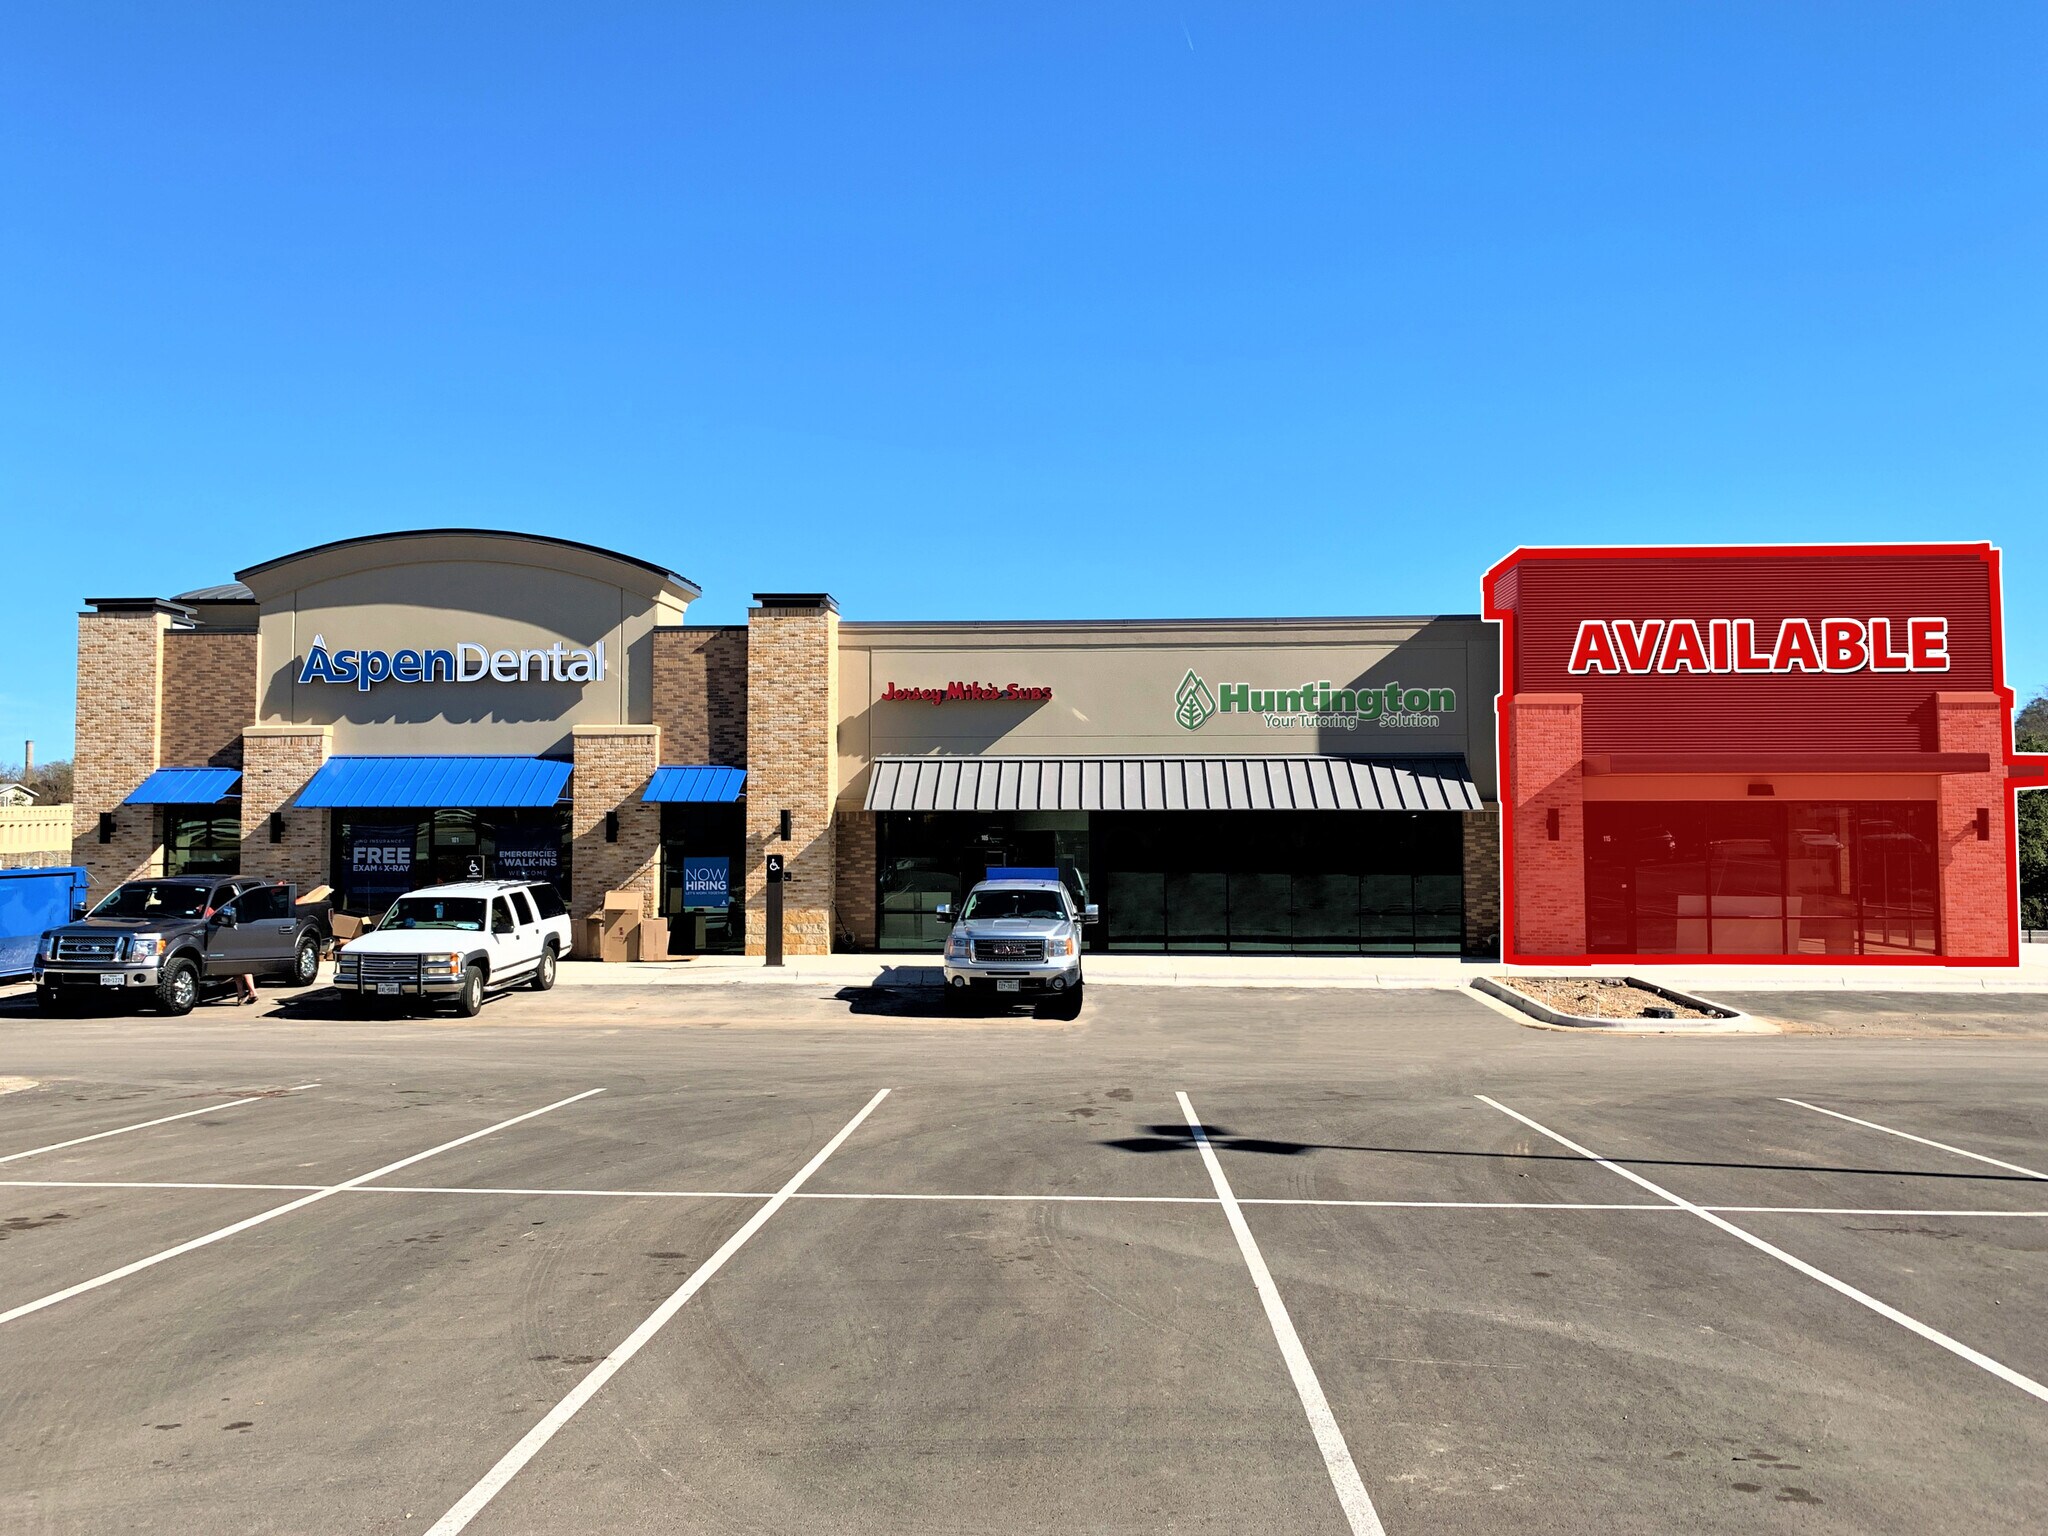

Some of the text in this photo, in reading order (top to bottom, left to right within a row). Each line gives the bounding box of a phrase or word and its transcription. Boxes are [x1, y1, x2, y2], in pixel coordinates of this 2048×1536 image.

[298, 634, 605, 691] AspenDental
[882, 682, 942, 705] Jersey
[946, 681, 1001, 700] Mike's
[1218, 680, 1456, 720] Huntington
[1262, 713, 1440, 730] Your Tutoring Solution
[353, 847, 411, 864] FREE
[504, 858, 558, 867] WALK-INS
[686, 868, 727, 881] NOW
[686, 881, 727, 890] HIRING
